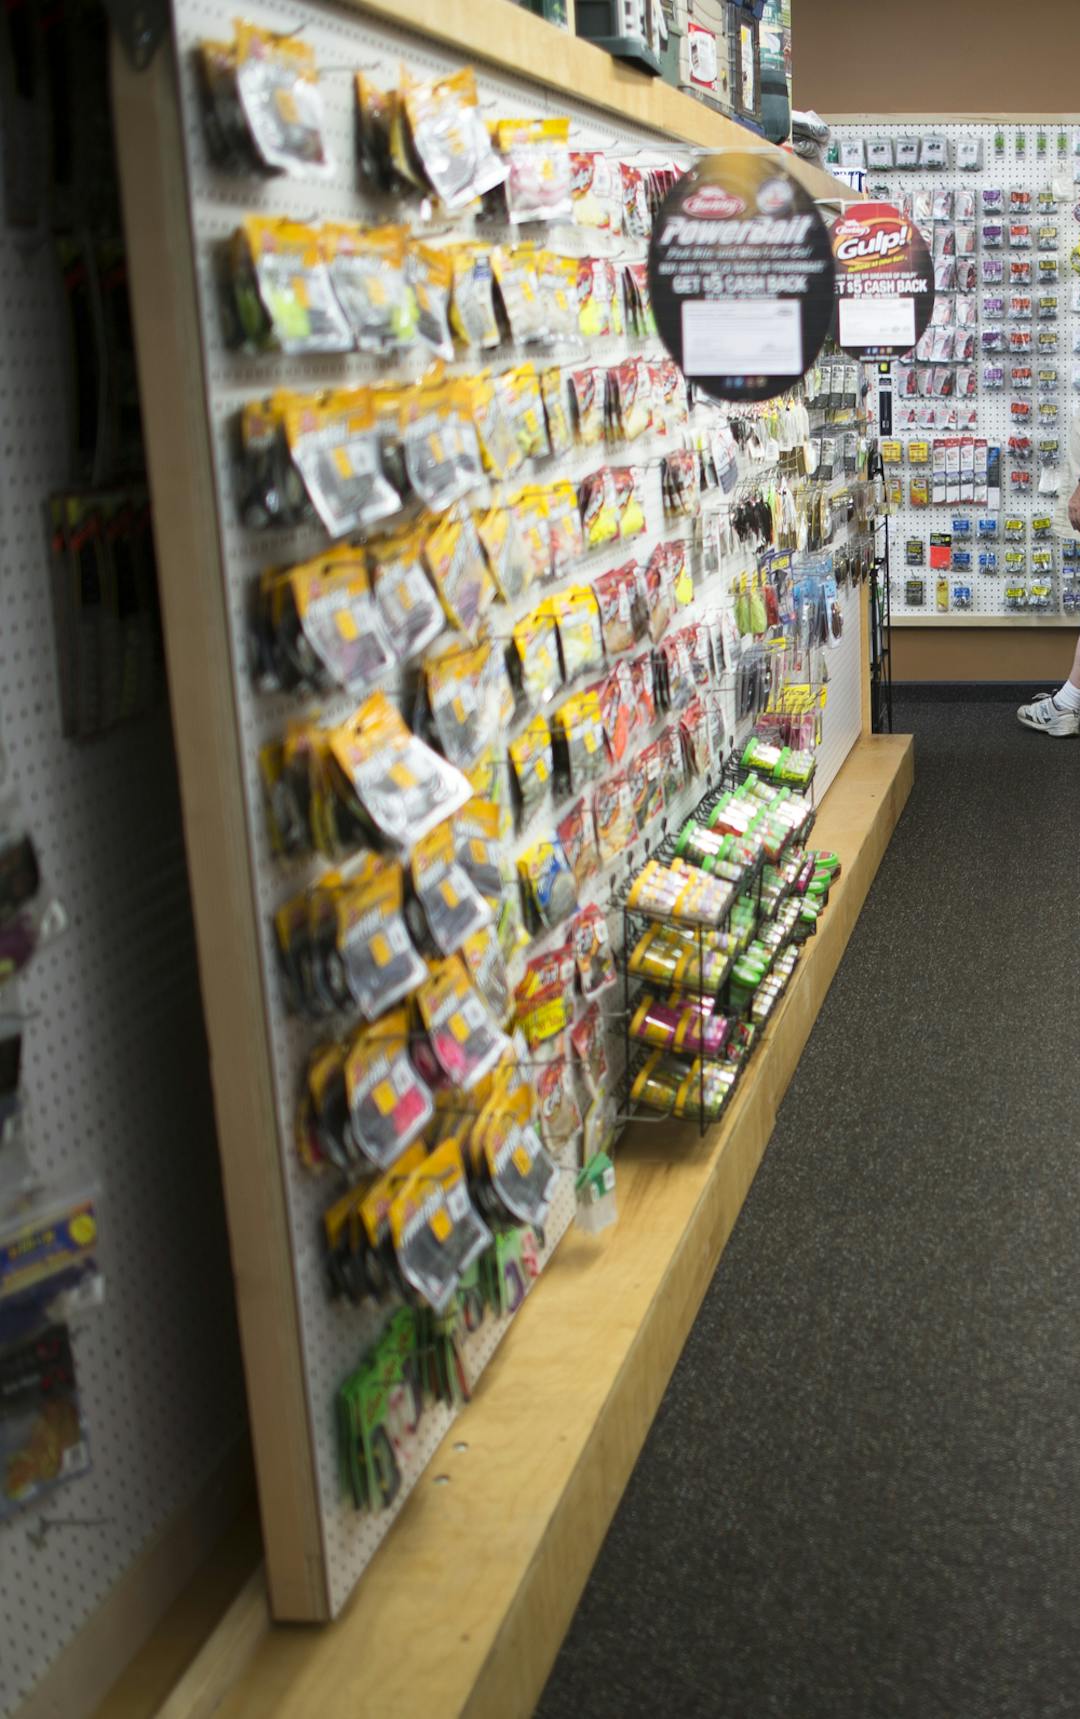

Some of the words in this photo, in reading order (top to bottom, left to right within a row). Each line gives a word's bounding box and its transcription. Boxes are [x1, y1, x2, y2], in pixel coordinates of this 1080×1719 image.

[659, 215, 814, 246] PowerBait
[837, 225, 909, 261] Gulp!
[673, 275, 701, 294] GET
[703, 272, 724, 294] $5
[725, 275, 766, 294] CASH
[767, 275, 810, 294] BACK
[847, 279, 863, 294] $5
[864, 280, 895, 294] CASH
[896, 279, 928, 294] BACK
